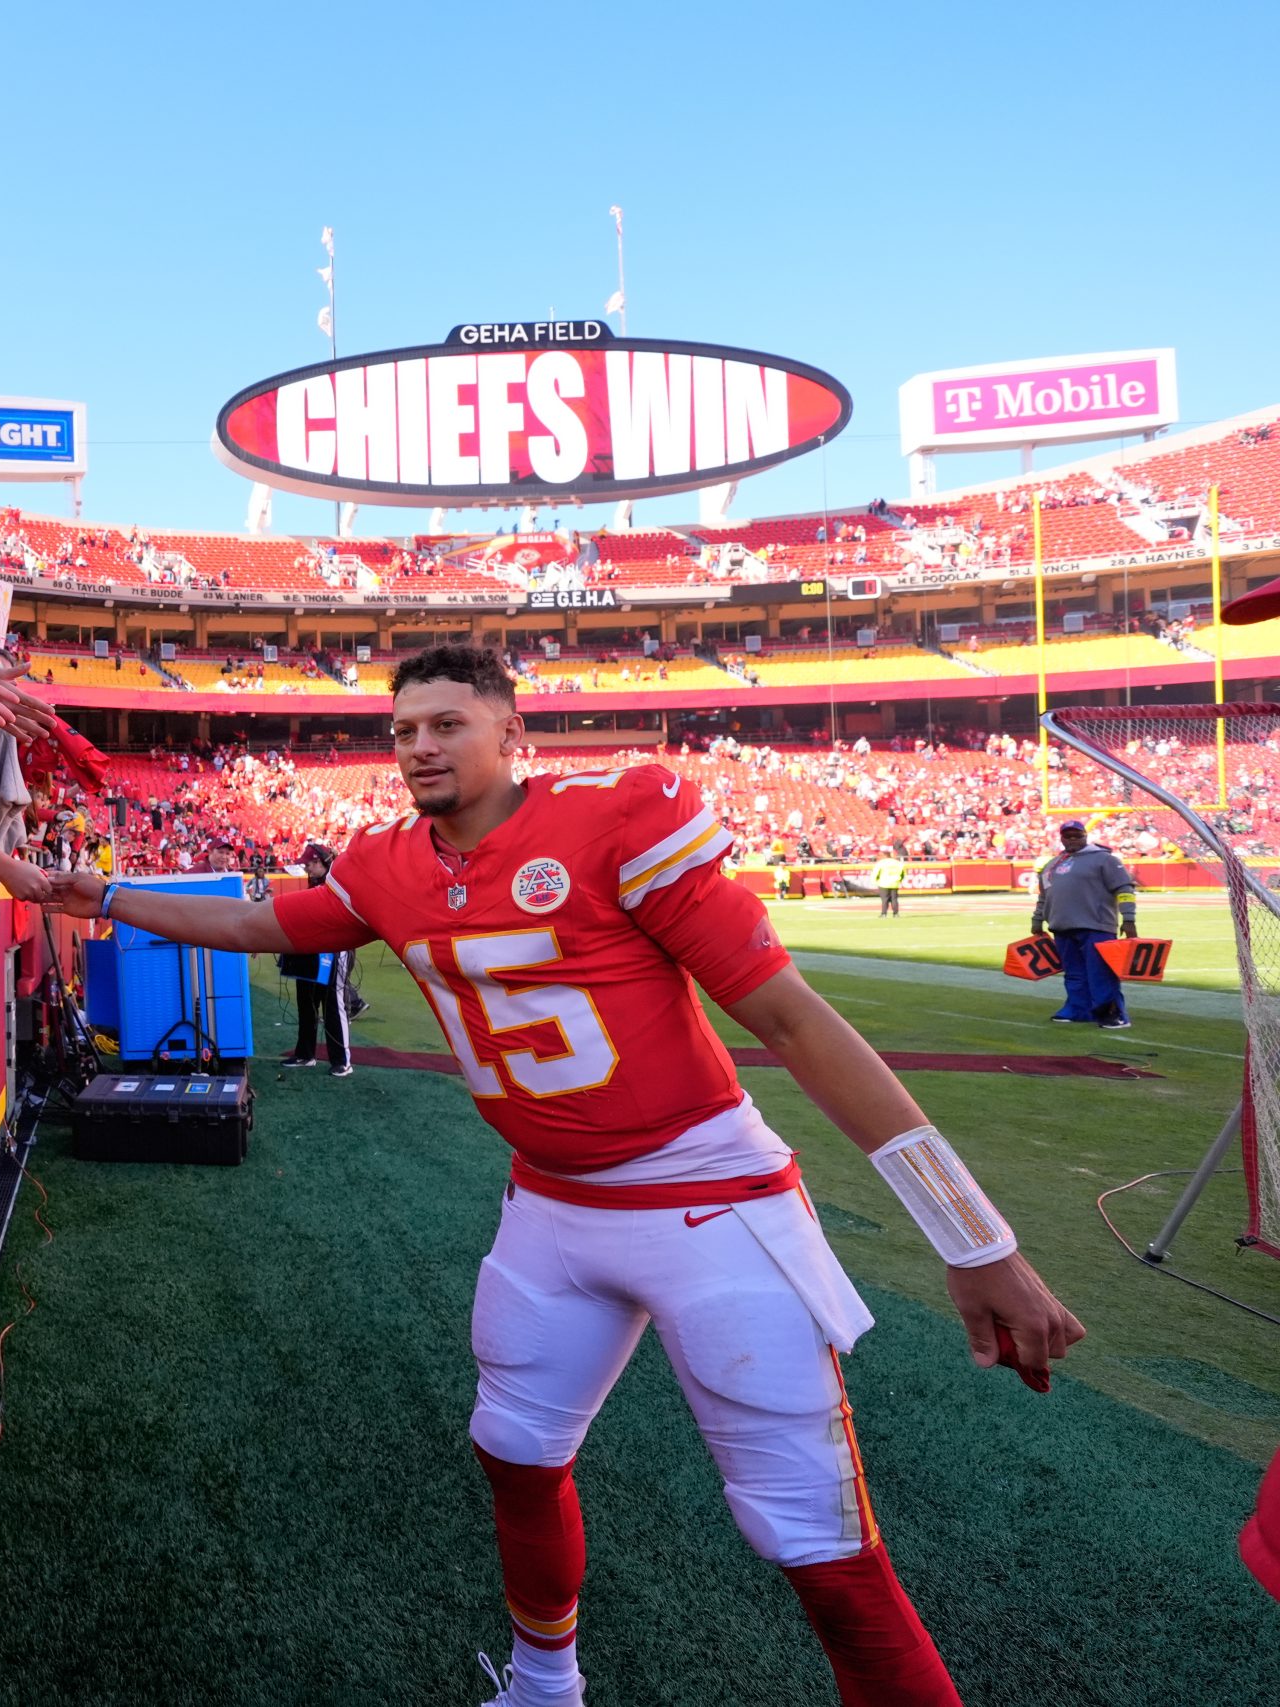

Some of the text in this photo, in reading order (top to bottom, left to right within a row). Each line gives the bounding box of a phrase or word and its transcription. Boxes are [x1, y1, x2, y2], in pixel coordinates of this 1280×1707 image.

[460, 321, 601, 344] GEHA FIELD
[991, 373, 1147, 420] Mobile
[276, 350, 789, 486] CHIEFS WIN
[1110, 548, 1207, 567] 28 A. HAYNES
[1009, 568, 1019, 577] 51
[1038, 563, 1080, 575] YNCH
[922, 571, 981, 584] PODOLAK
[76, 583, 112, 595] TAYLOR
[150, 589, 184, 599] BUDDE
[227, 592, 263, 602] LANIER
[303, 594, 344, 603] THOMAS
[363, 594, 428, 604] HANK STRAM
[471, 594, 508, 603] WILSON
[1017, 937, 1064, 977] 20
[402, 926, 621, 1099] 15
